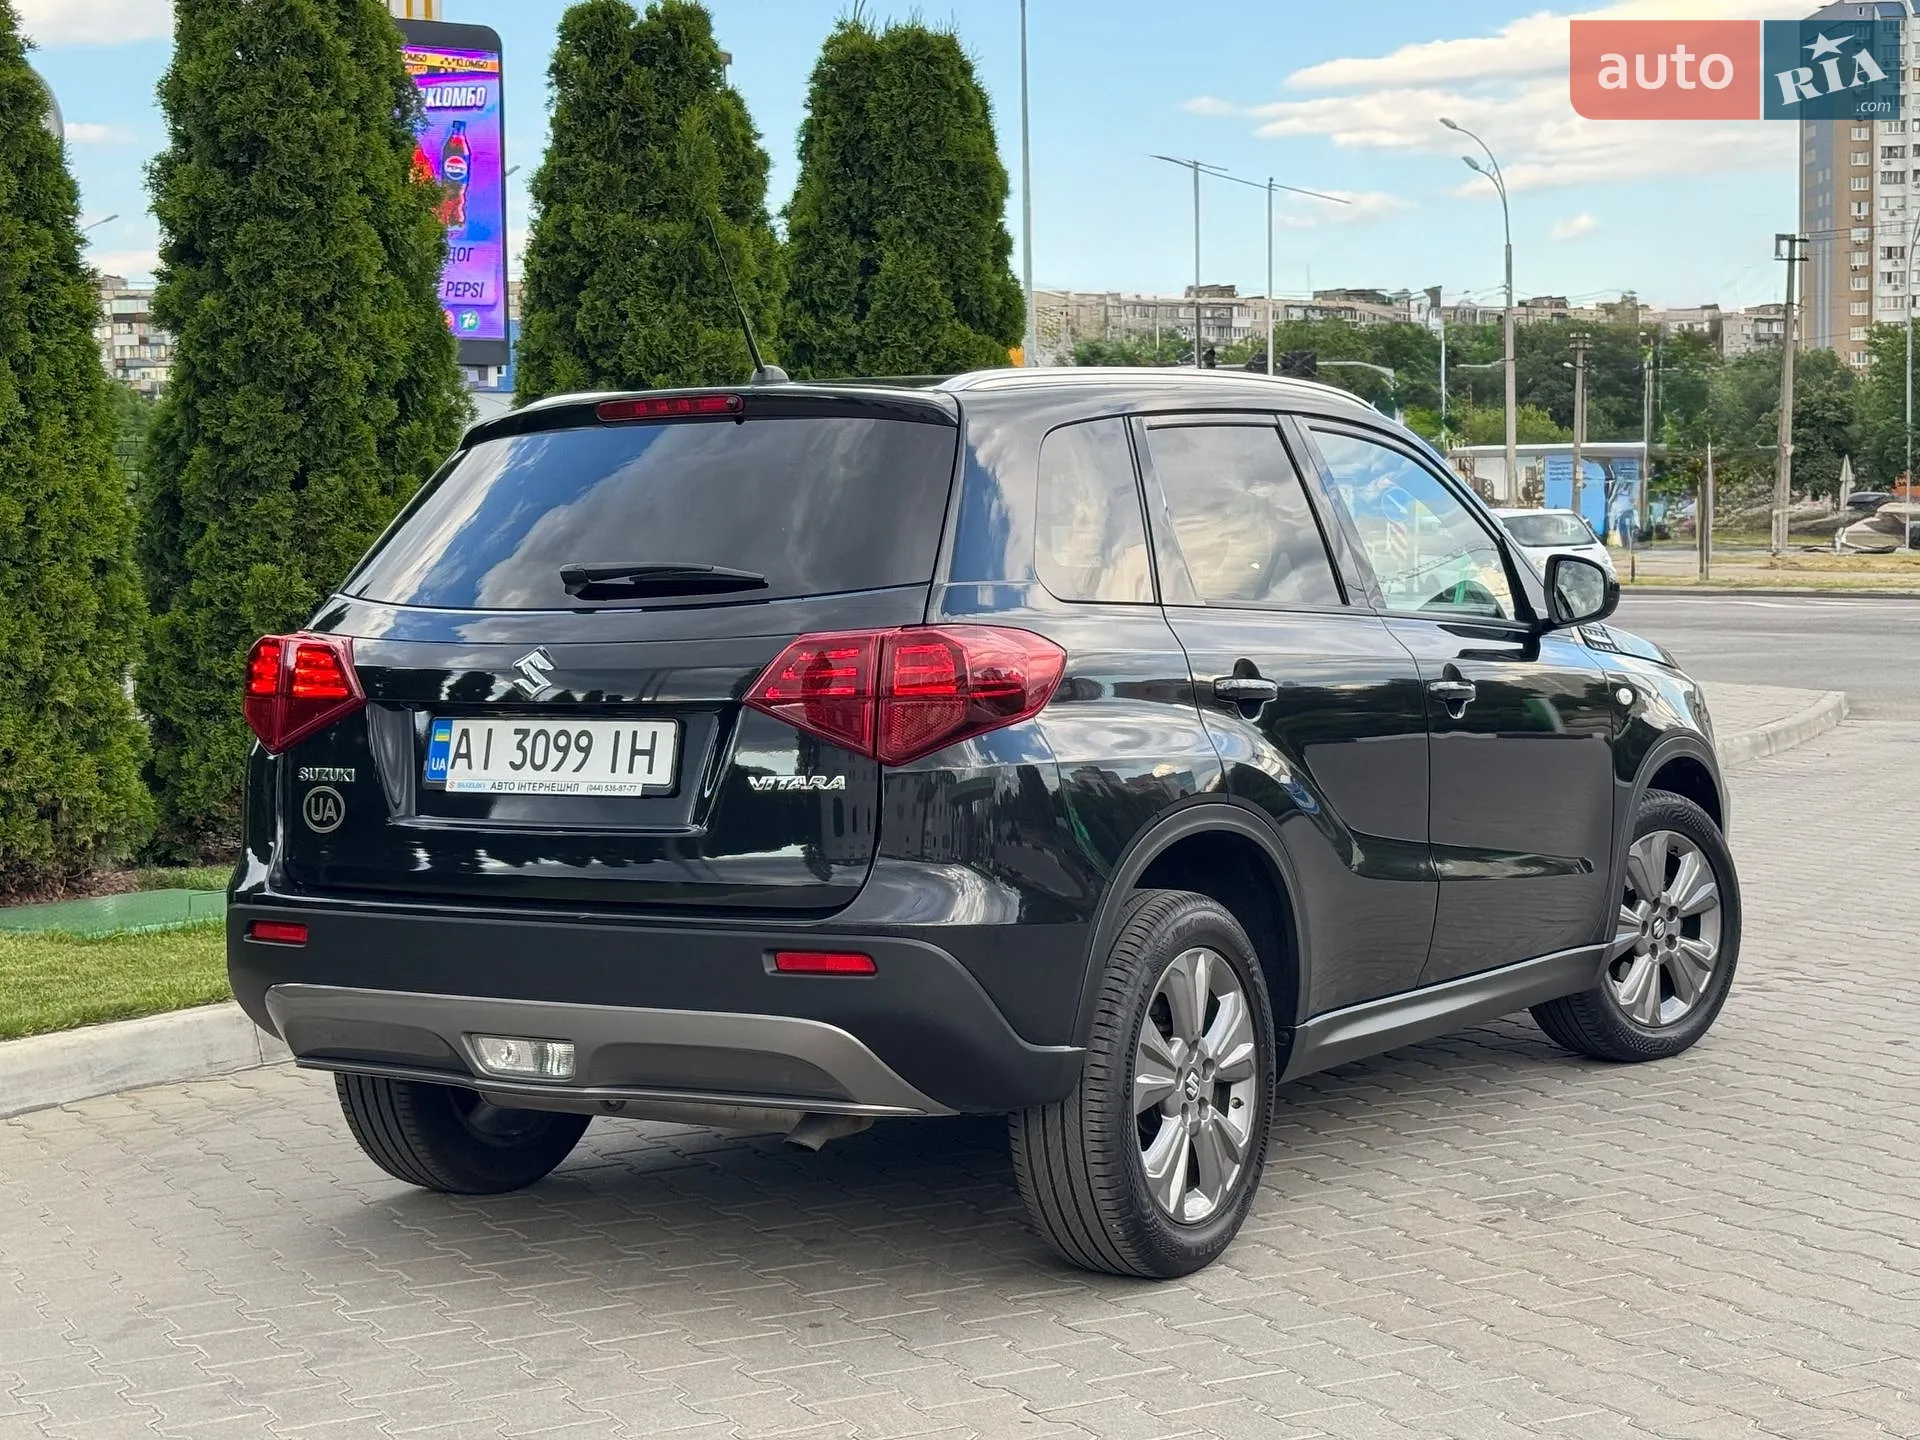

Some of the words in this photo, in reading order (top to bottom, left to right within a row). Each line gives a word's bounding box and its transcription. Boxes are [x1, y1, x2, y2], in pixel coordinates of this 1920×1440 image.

[445, 281, 484, 298] PEPSI
[450, 728, 493, 771] AI
[509, 728, 594, 773] 3099
[610, 730, 657, 775] IH
[431, 757, 446, 771] UA
[298, 766, 356, 782] SUZUKI
[490, 782, 515, 791] АВТО
[517, 783, 580, 792] ІНТЕРНЕШНЛ
[747, 775, 846, 790] VITARA
[311, 797, 338, 821] UA
[1122, 992, 1146, 1101] Continental
